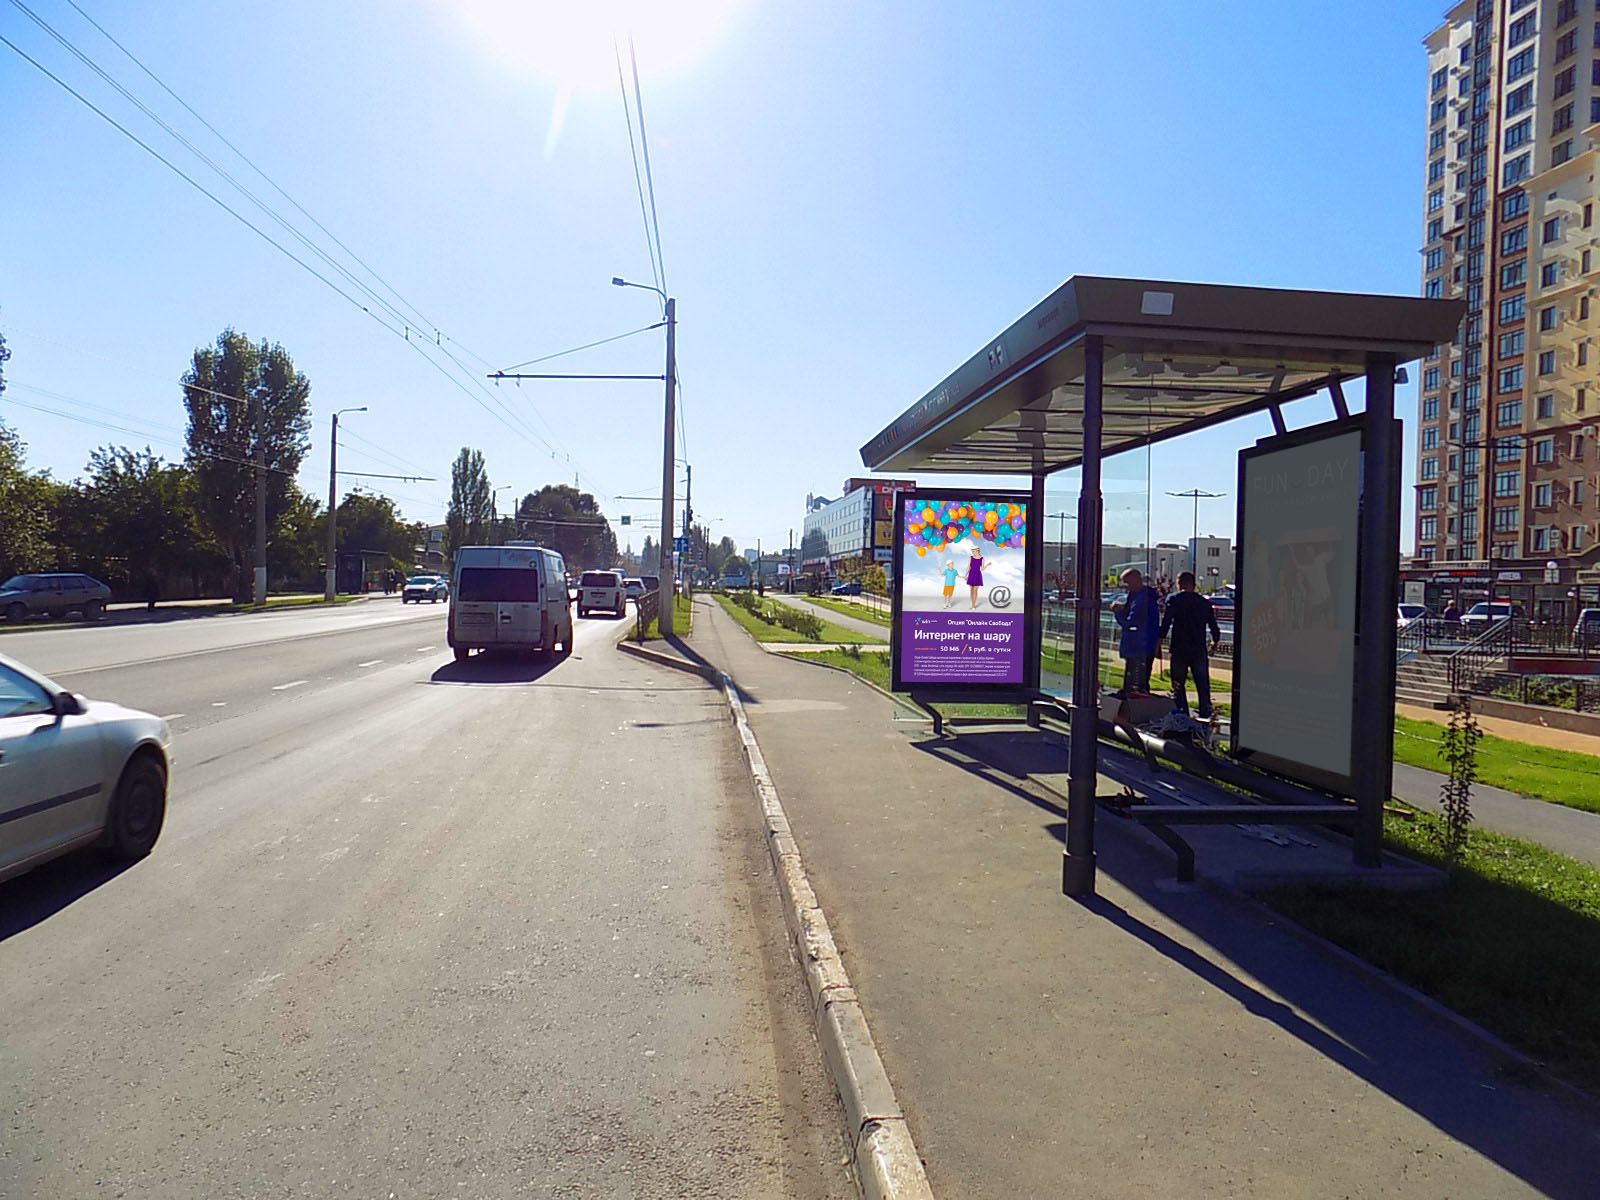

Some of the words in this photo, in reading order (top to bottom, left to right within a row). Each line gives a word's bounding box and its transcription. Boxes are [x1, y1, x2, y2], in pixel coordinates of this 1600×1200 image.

[1252, 471, 1288, 496] FUN
[1306, 458, 1349, 488] DAY
[988, 585, 1011, 609] @
[1250, 608, 1274, 635] SALE
[914, 629, 965, 642] Интернет
[983, 633, 1011, 643] шару
